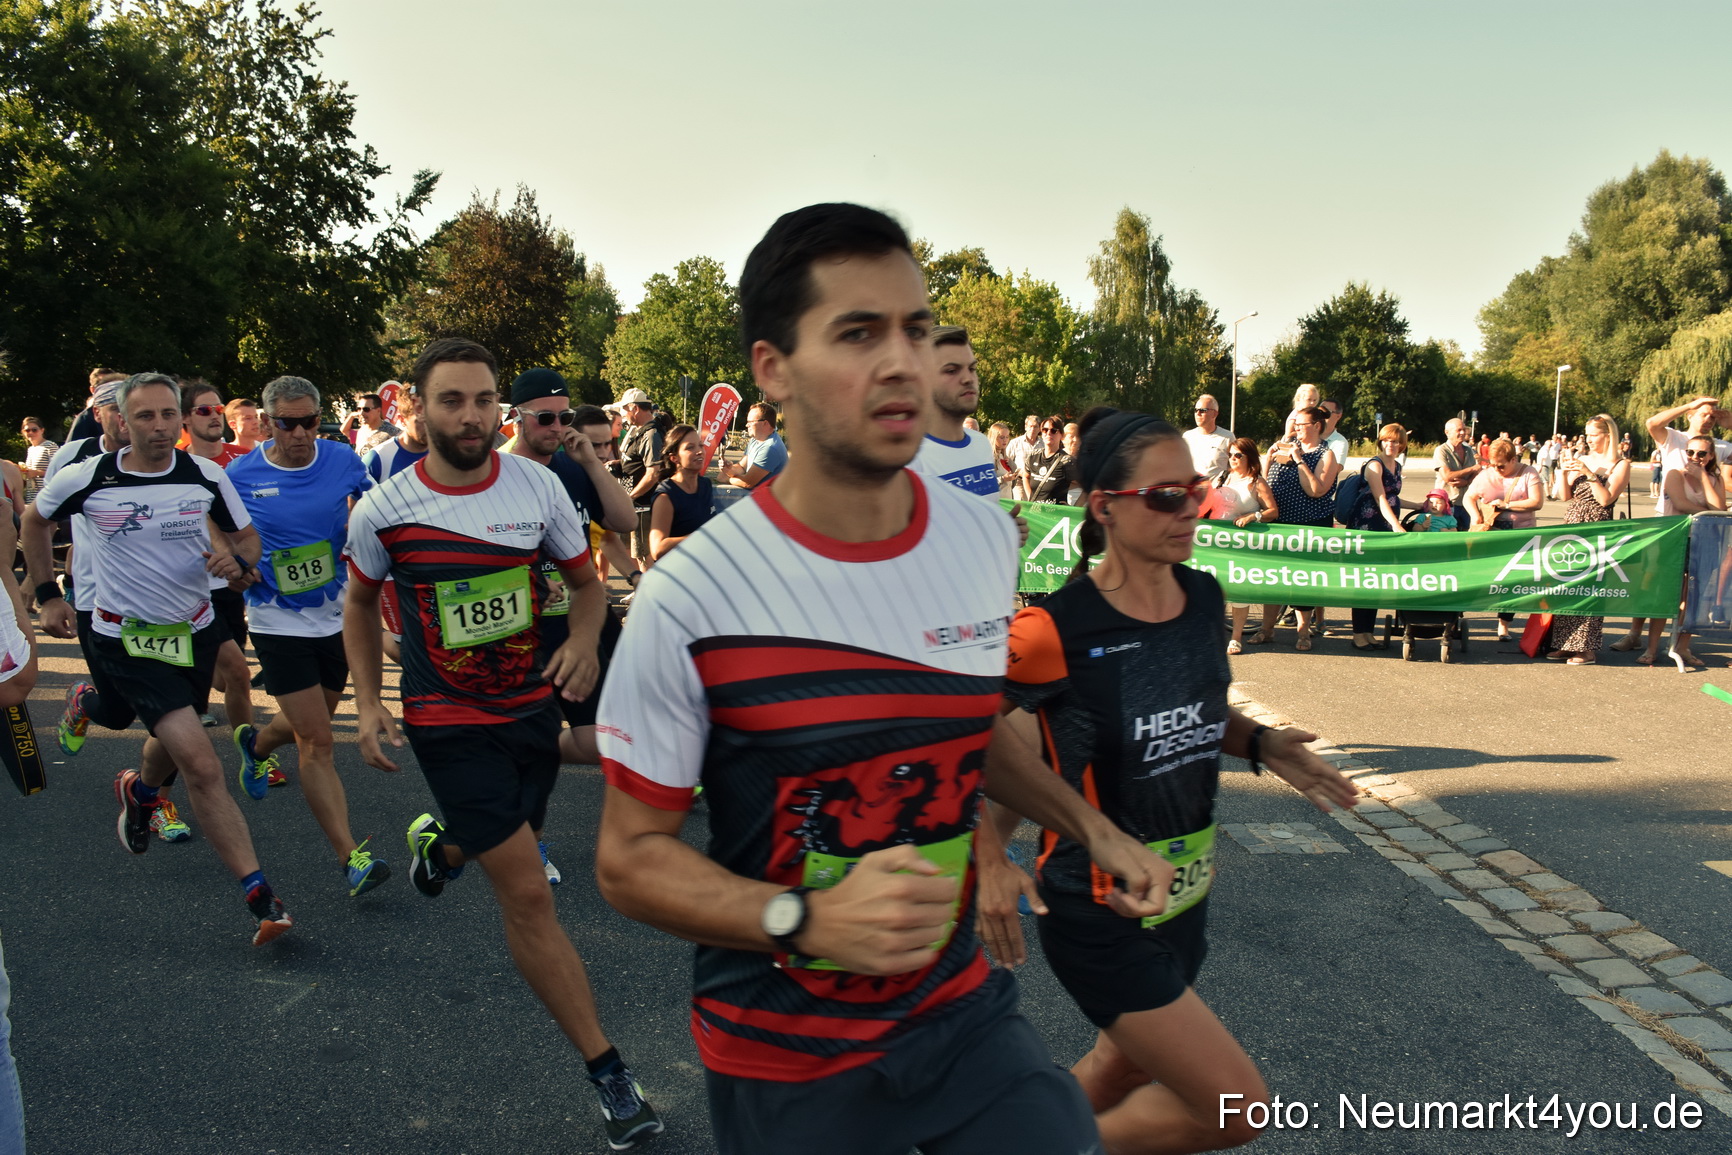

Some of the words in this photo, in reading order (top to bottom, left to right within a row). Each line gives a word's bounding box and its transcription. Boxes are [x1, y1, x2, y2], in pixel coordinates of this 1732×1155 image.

[486, 522, 539, 533] NEUMARKT
[1193, 525, 1366, 555] Gesundheit
[287, 559, 323, 581] 818
[1024, 561, 1044, 574] Die
[1493, 534, 1635, 583] AOK
[1228, 561, 1329, 587] besten
[1339, 567, 1459, 592] Händen
[1488, 584, 1510, 596] Die
[1511, 584, 1631, 599] Gesundheitskasse.
[453, 592, 518, 628] 1881
[131, 636, 180, 655] 1471
[1134, 702, 1204, 741] HECK
[13, 722, 35, 757] D750
